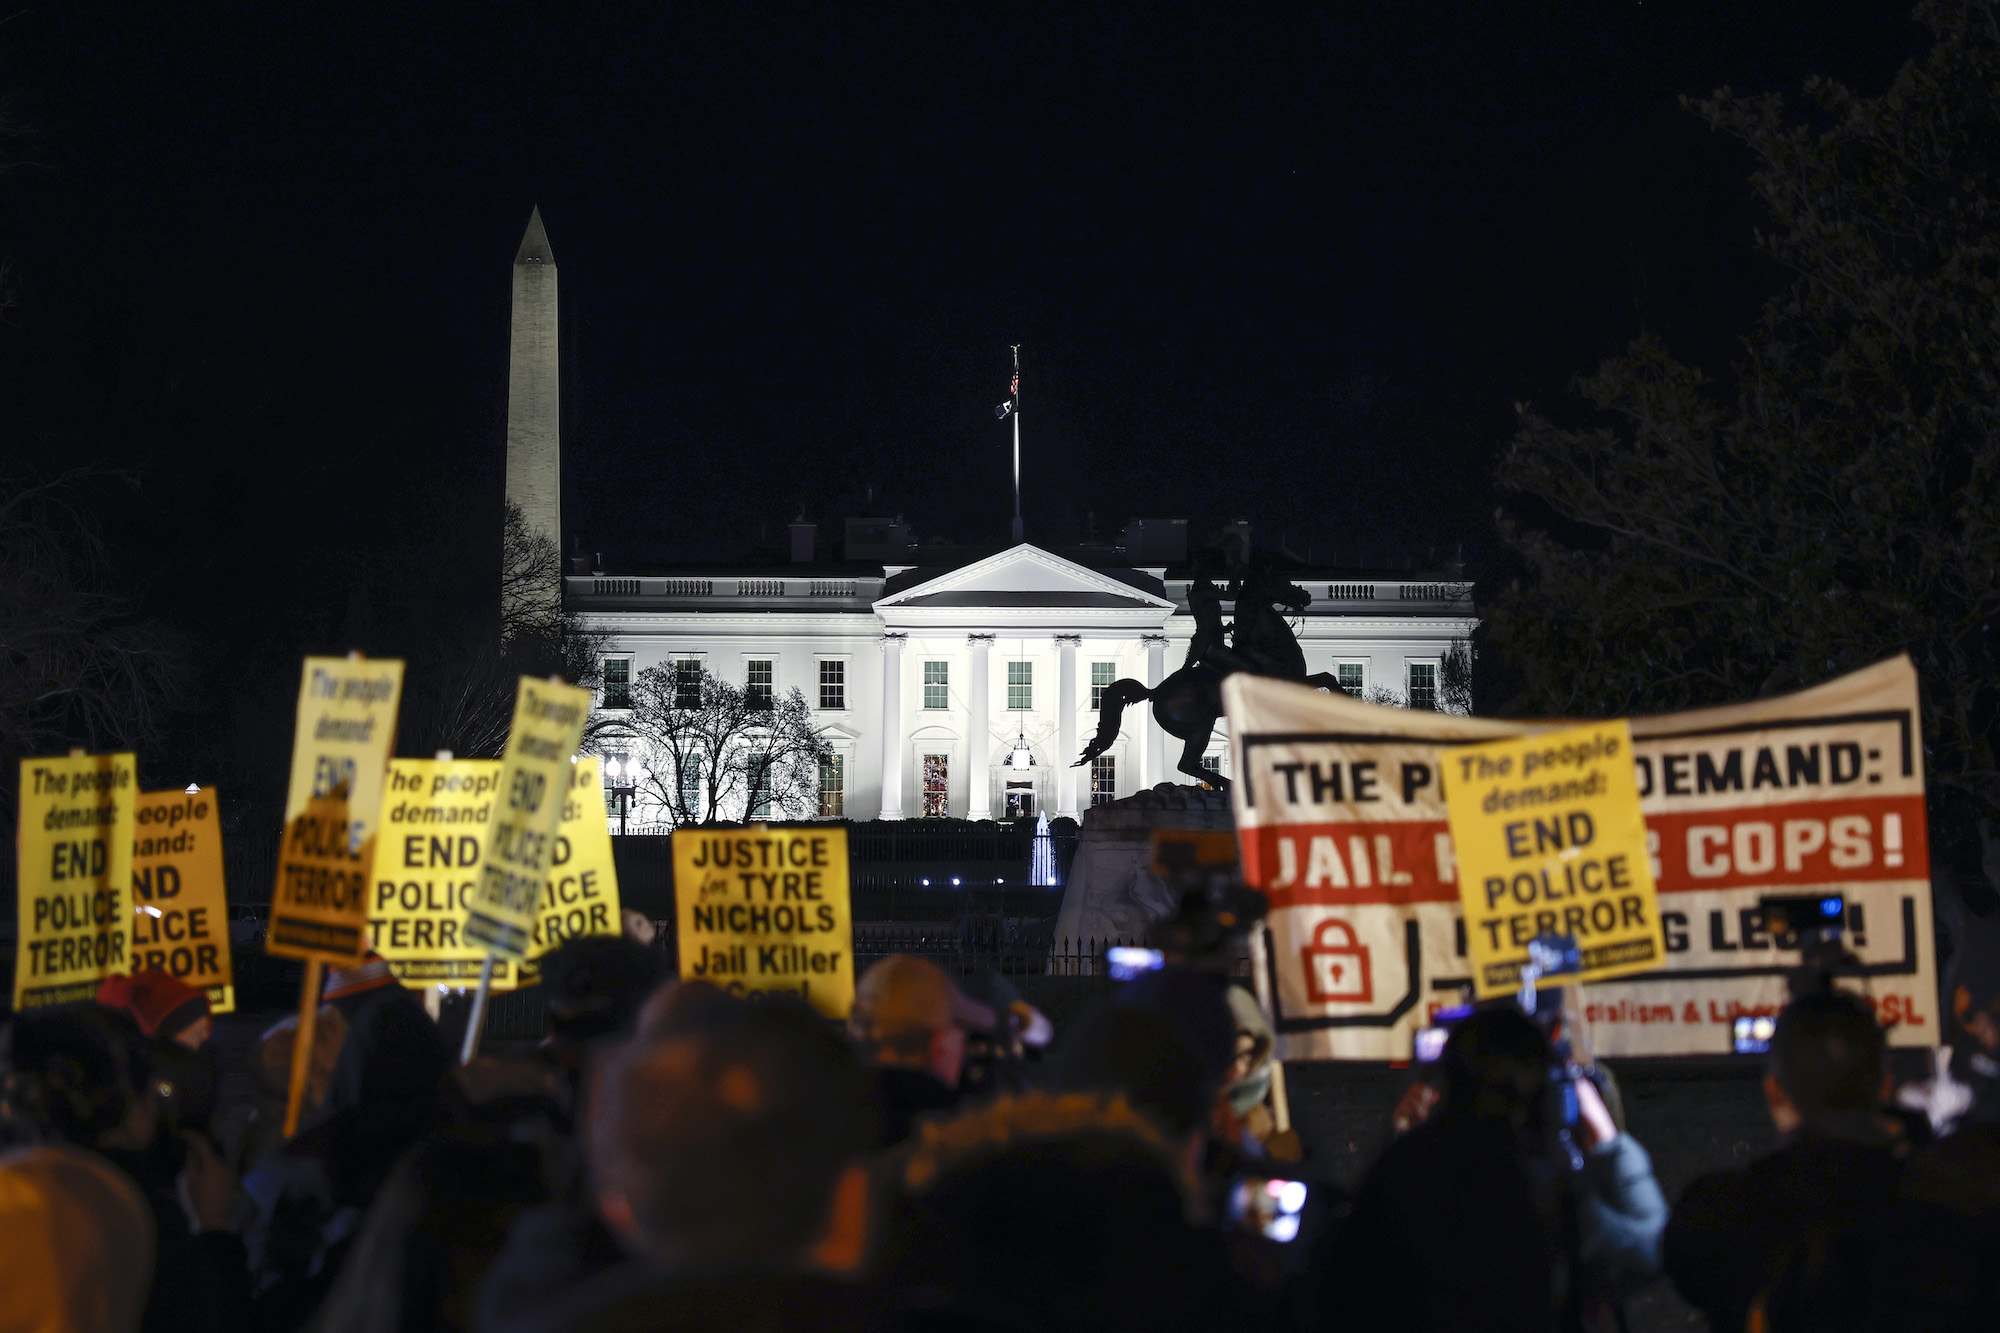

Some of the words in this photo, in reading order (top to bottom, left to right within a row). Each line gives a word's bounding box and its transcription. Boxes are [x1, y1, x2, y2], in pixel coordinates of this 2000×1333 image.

[1458, 753, 1517, 785] The
[1523, 731, 1620, 779] people
[33, 768, 68, 795] The
[72, 763, 130, 799] people
[387, 769, 421, 792] he
[431, 771, 498, 796] peopl
[1273, 762, 1381, 806] THE
[1482, 772, 1607, 814] demand:
[136, 797, 208, 828] eople
[390, 801, 489, 825] demand
[404, 835, 480, 868] END
[693, 838, 828, 868] JUSTICE
[1269, 835, 1413, 889] JAIL
[1686, 813, 1904, 878] COPS!
[1504, 811, 1594, 860] END
[52, 838, 107, 881] END
[132, 865, 181, 900] ND
[377, 881, 476, 911] POLIC
[738, 872, 822, 900] TYRE
[1485, 855, 1632, 910] POLICE
[34, 890, 121, 933] POLICE
[132, 908, 209, 945] LICE
[693, 904, 835, 933] NICHOLS
[1481, 895, 1647, 952] TERROR
[367, 918, 461, 948] TERR
[28, 932, 125, 977] TERROR
[693, 946, 746, 975] Jail
[758, 946, 841, 975] Killer
[1587, 1000, 1673, 1025] cialism
[1684, 1002, 1702, 1024] &
[1870, 994, 1925, 1027] SL
